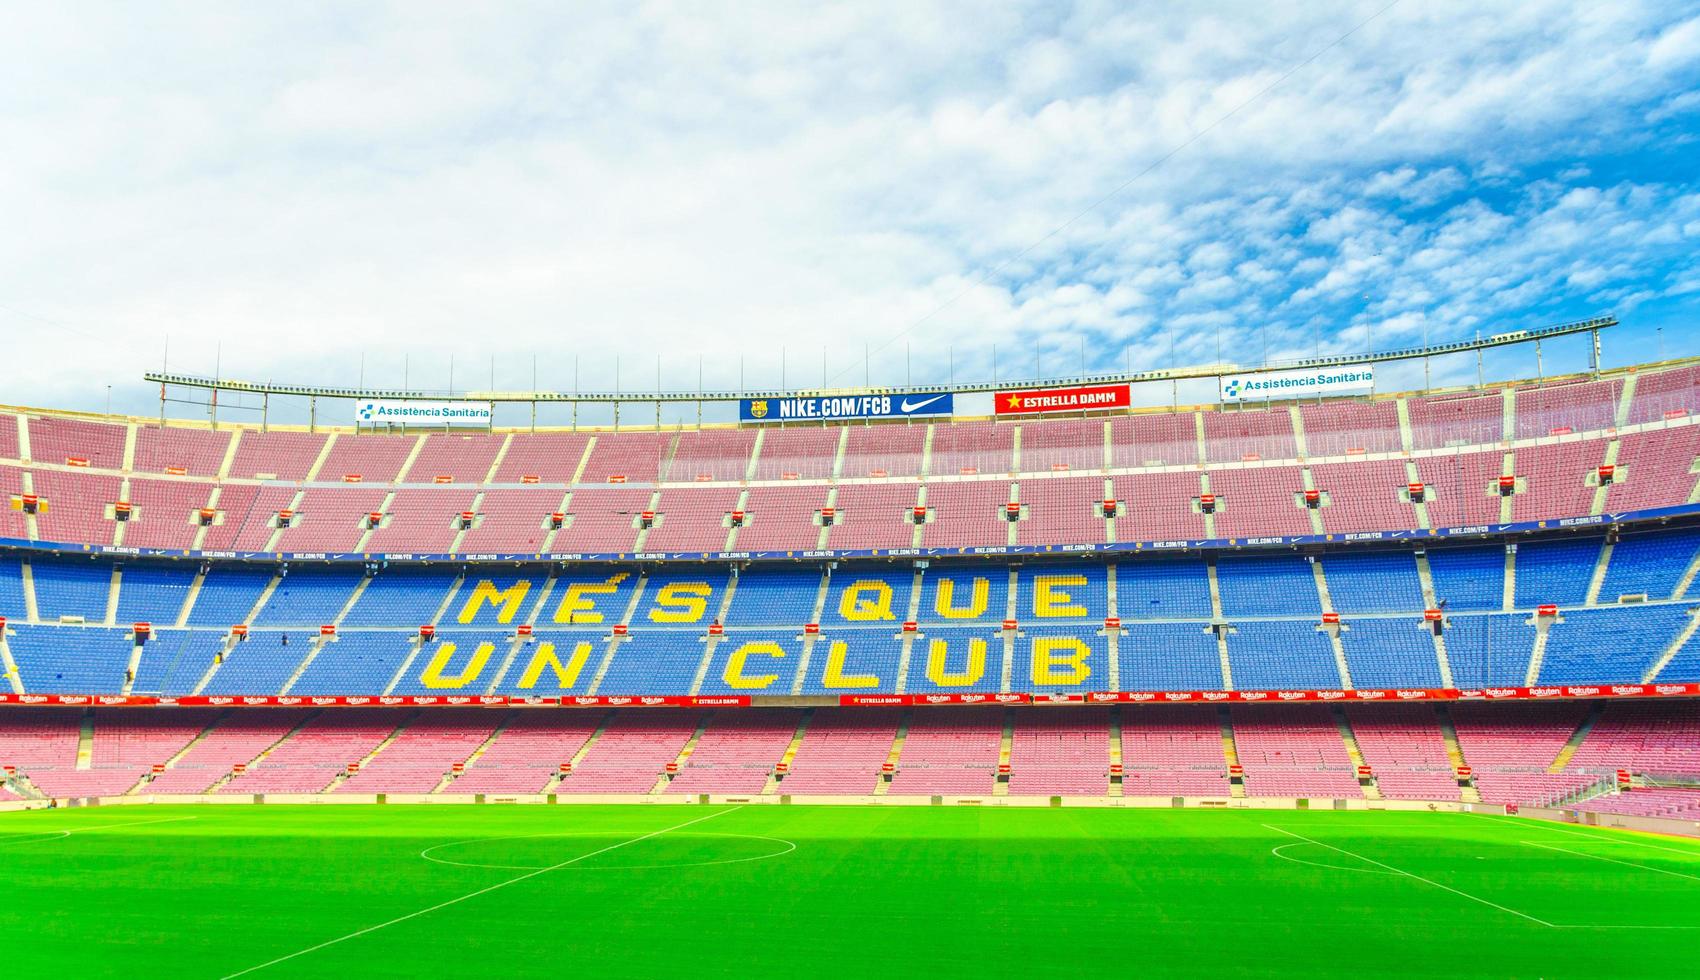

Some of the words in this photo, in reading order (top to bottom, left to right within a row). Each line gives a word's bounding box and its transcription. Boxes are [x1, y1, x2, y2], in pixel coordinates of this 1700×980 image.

[1244, 376, 1316, 390] Assistència
[1317, 371, 1373, 384] Sanitària
[1023, 393, 1078, 408] ESTRELLA
[1079, 392, 1116, 404] DAMM
[779, 396, 891, 417] NIKE.COM/FCB
[377, 406, 441, 417] Assistència
[442, 407, 489, 418] Sanitària
[457, 572, 713, 624] MÉS
[838, 575, 1088, 621] QUE
[420, 642, 596, 689] UN
[723, 636, 1091, 689] CLUB
[1356, 690, 1385, 699] Rakuten
[1397, 689, 1425, 699] Rakuten
[1485, 688, 1516, 698] Rakuten
[1529, 687, 1560, 697] Rakuten
[1568, 686, 1599, 696] Rakuten
[1612, 685, 1643, 695] Rakuten
[1655, 685, 1686, 696] Rakuten
[18, 695, 47, 703] Rakuten
[926, 695, 950, 703] Rakuten
[960, 694, 985, 703] Rakuten
[995, 694, 1019, 702] Rakuten
[1093, 693, 1118, 701] Rakuten
[1129, 692, 1154, 701] Rakuten
[1165, 692, 1192, 701] Rakuten
[1202, 692, 1229, 701] Rakuten
[1240, 691, 1267, 700] Rakuten
[1278, 691, 1305, 700] Rakuten
[1317, 690, 1345, 700] Rakuten
[59, 696, 86, 704] Rakuten
[99, 696, 126, 705] Rakuten
[208, 696, 233, 705] Rakuten
[243, 696, 267, 705] Rakuten
[277, 696, 301, 705] Rakuten
[312, 697, 336, 705] Rakuten
[346, 696, 370, 705] Rakuten
[379, 696, 403, 705] Rakuten
[413, 696, 437, 705] Rakuten
[446, 696, 470, 705] Rakuten
[479, 696, 503, 705] Rakuten
[575, 697, 598, 705] Rakuten
[608, 696, 631, 705] Rakuten
[641, 696, 664, 705] Rakuten
